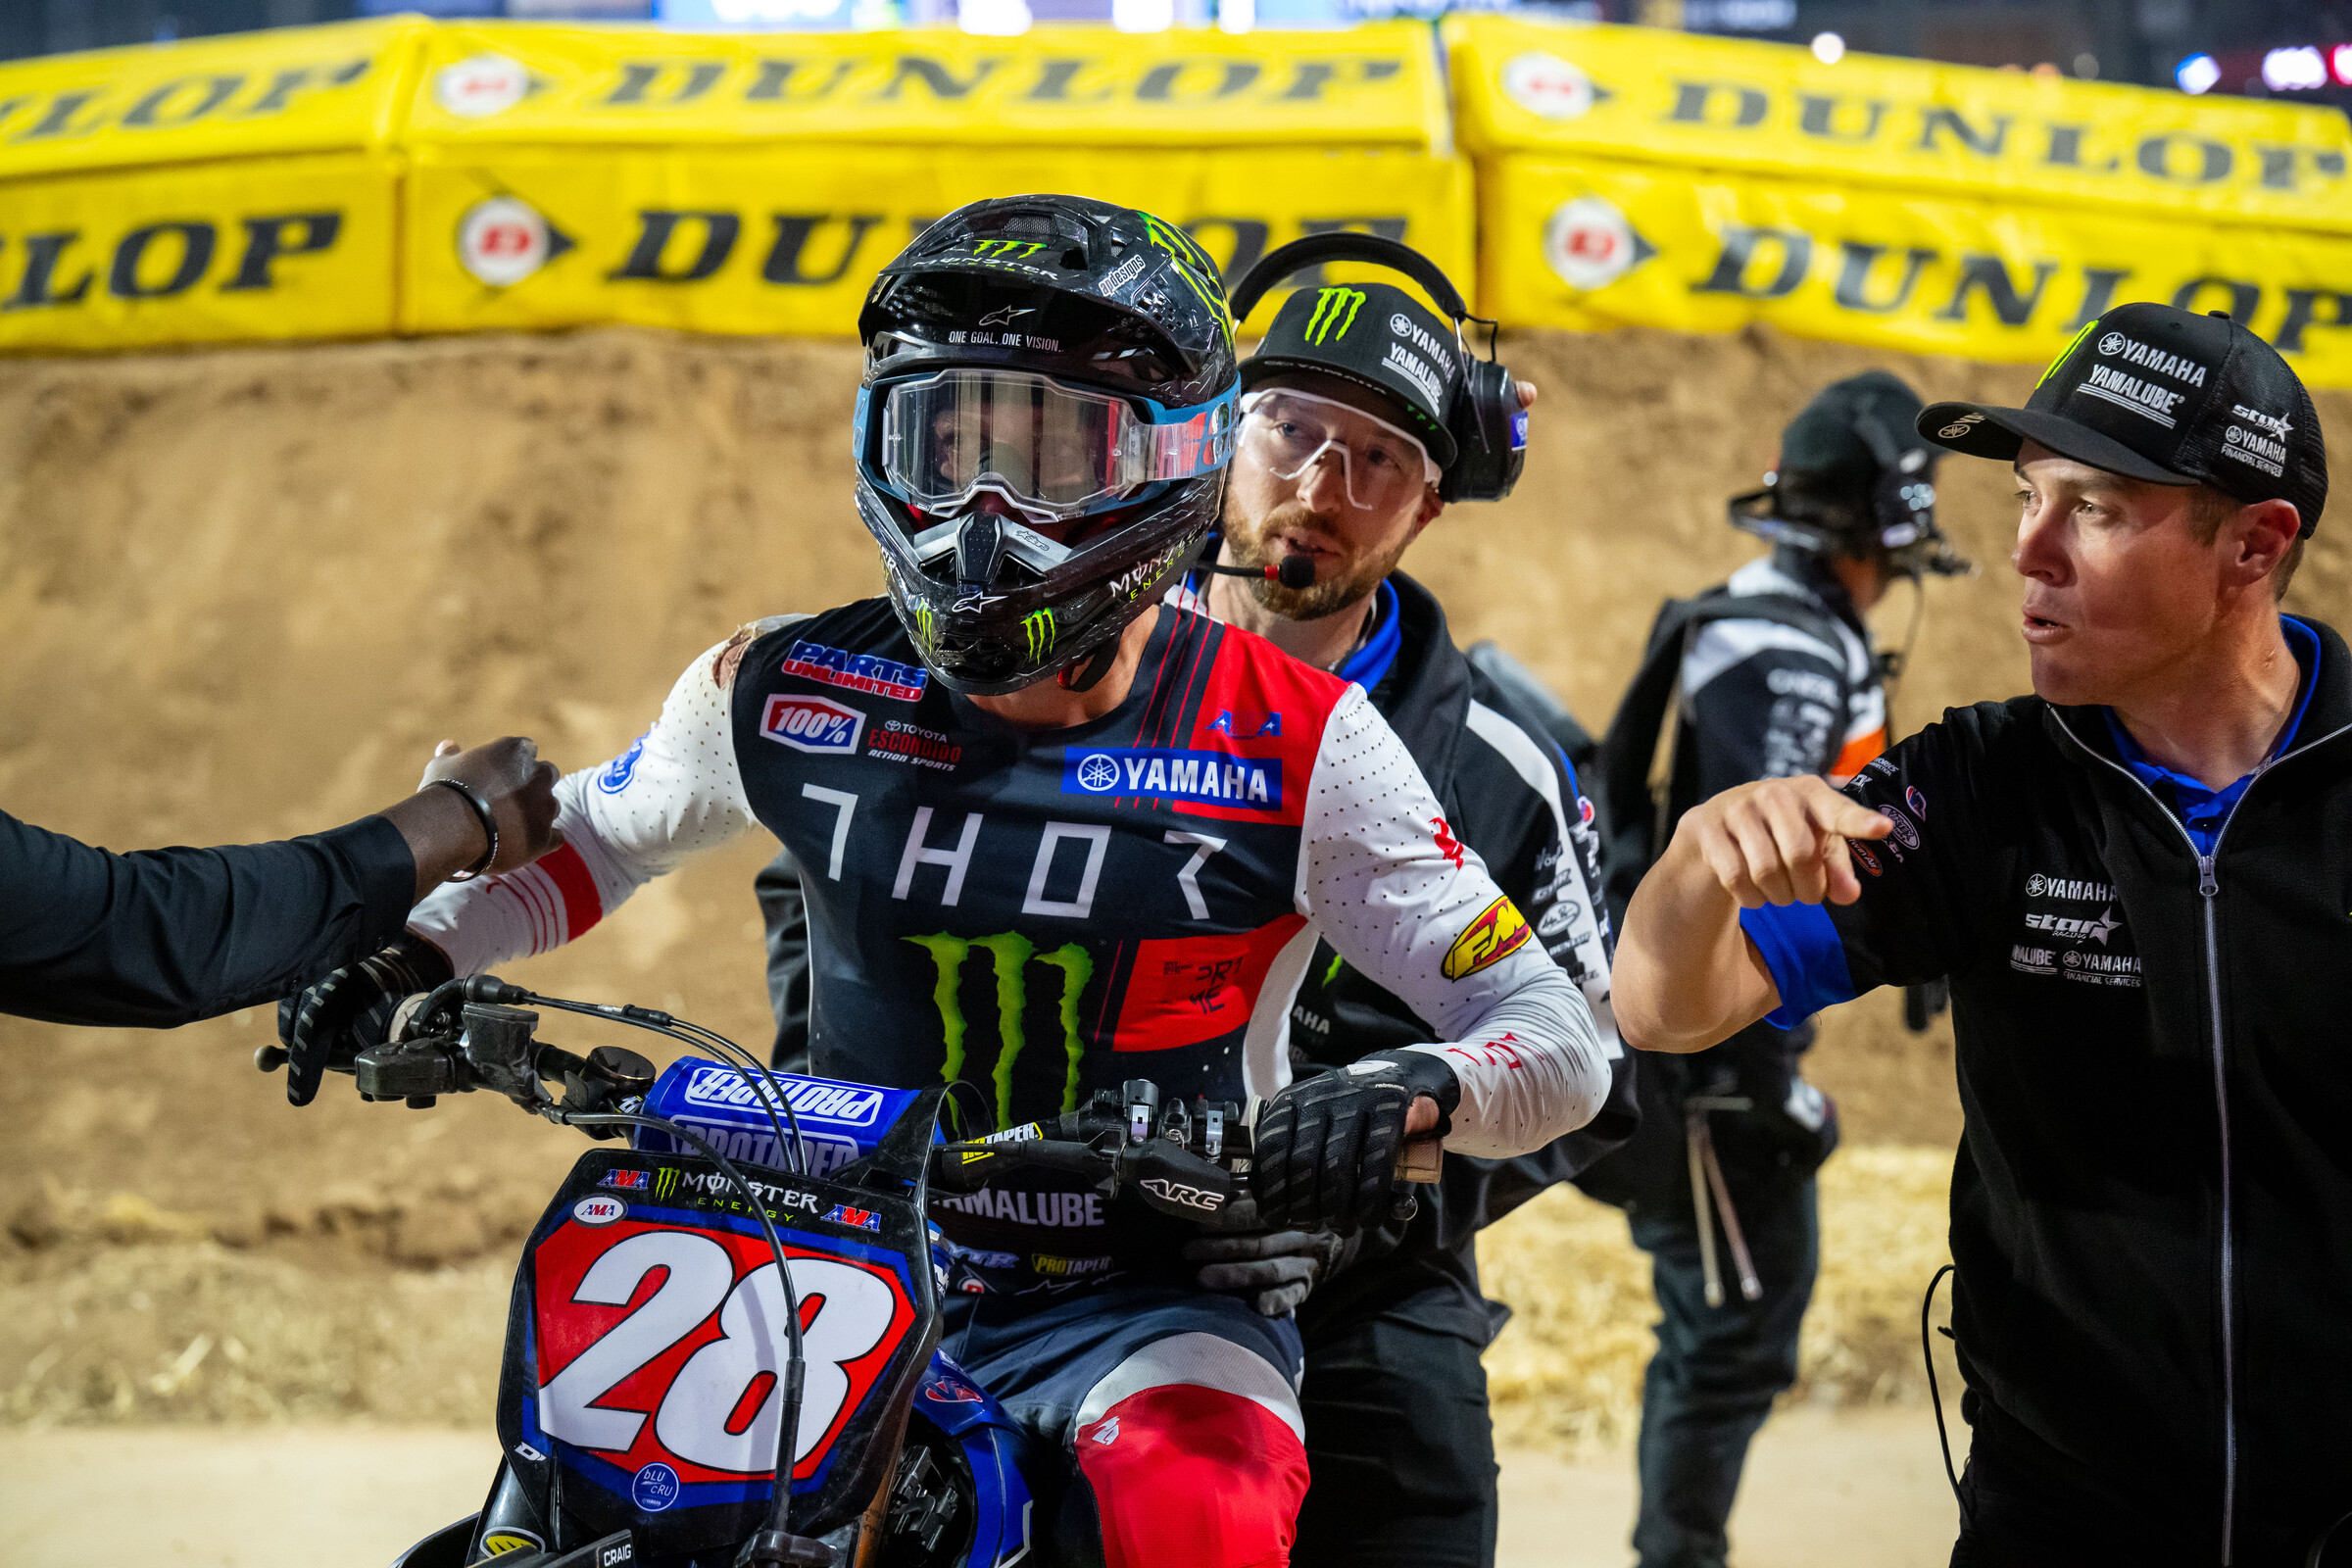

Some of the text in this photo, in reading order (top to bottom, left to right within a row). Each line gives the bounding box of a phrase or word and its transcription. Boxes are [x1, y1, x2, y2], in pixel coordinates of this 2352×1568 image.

[596, 56, 1403, 106] DUNLOP
[0, 61, 370, 145] LOP
[1666, 81, 2347, 192] DUNLOP
[0, 212, 343, 312] LOP
[604, 209, 1408, 291] DUOP
[1100, 253, 1147, 297] apdesigns
[949, 330, 1062, 353] ONE GOAL. ONE VISION.
[1410, 323, 1456, 383] YAMAHA
[1389, 341, 1445, 404] YAMALUBE
[2122, 338, 2208, 388] YAMAHA
[2221, 445, 2283, 478] FINANCIAL SERVICES
[2242, 430, 2287, 465] YAMAHA
[782, 660, 923, 703] UNLIMITED
[786, 639, 929, 690] PARTS
[774, 705, 847, 745] 100%
[868, 728, 962, 762] ESCONDIDO
[903, 723, 948, 744] TOYOTA
[867, 749, 956, 772] ACTION SPORTS
[1124, 758, 1269, 803] YAMAHA
[2046, 878, 2119, 902] YAMAHA
[2064, 970, 2142, 988] FINANCIAL SERVICES
[2082, 954, 2142, 973] YAMAHA
[1292, 1004, 1331, 1035] AHA
[596, 1168, 652, 1191] AMA
[681, 1170, 819, 1214] MONSTER
[1140, 1178, 1225, 1211] ARC
[580, 1203, 615, 1217] AMA
[820, 1204, 882, 1234] AMA
[932, 1187, 1104, 1227] AMALUBE
[538, 1229, 897, 1474] 28
[604, 1544, 632, 1568] CRAIG
